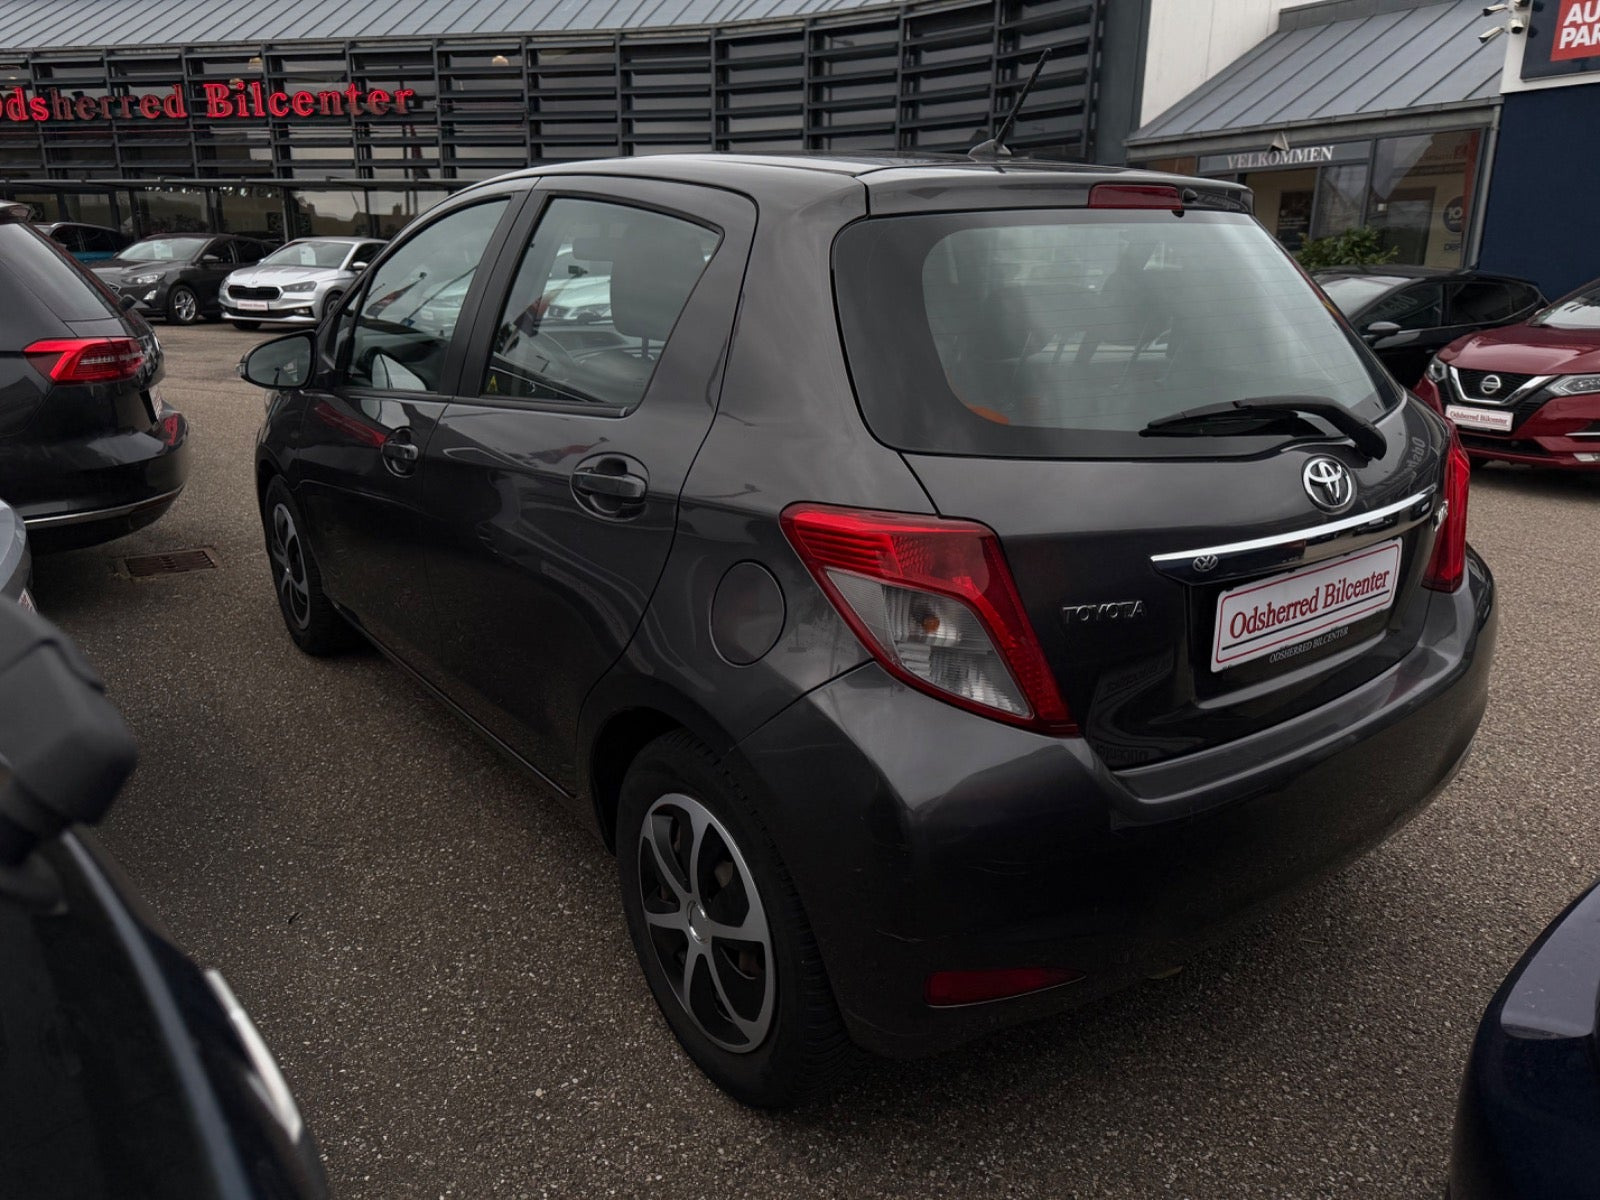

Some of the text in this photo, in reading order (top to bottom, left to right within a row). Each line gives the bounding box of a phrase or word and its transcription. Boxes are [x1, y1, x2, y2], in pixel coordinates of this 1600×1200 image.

[0, 82, 414, 121] dsherred Bilcenter
[1227, 145, 1335, 169] VELKOMMEN
[1062, 600, 1146, 624] TOYOTA
[1229, 570, 1390, 639] Odsherred Bilcenter
[1269, 626, 1349, 664] ODSHERRED BILCENTER
